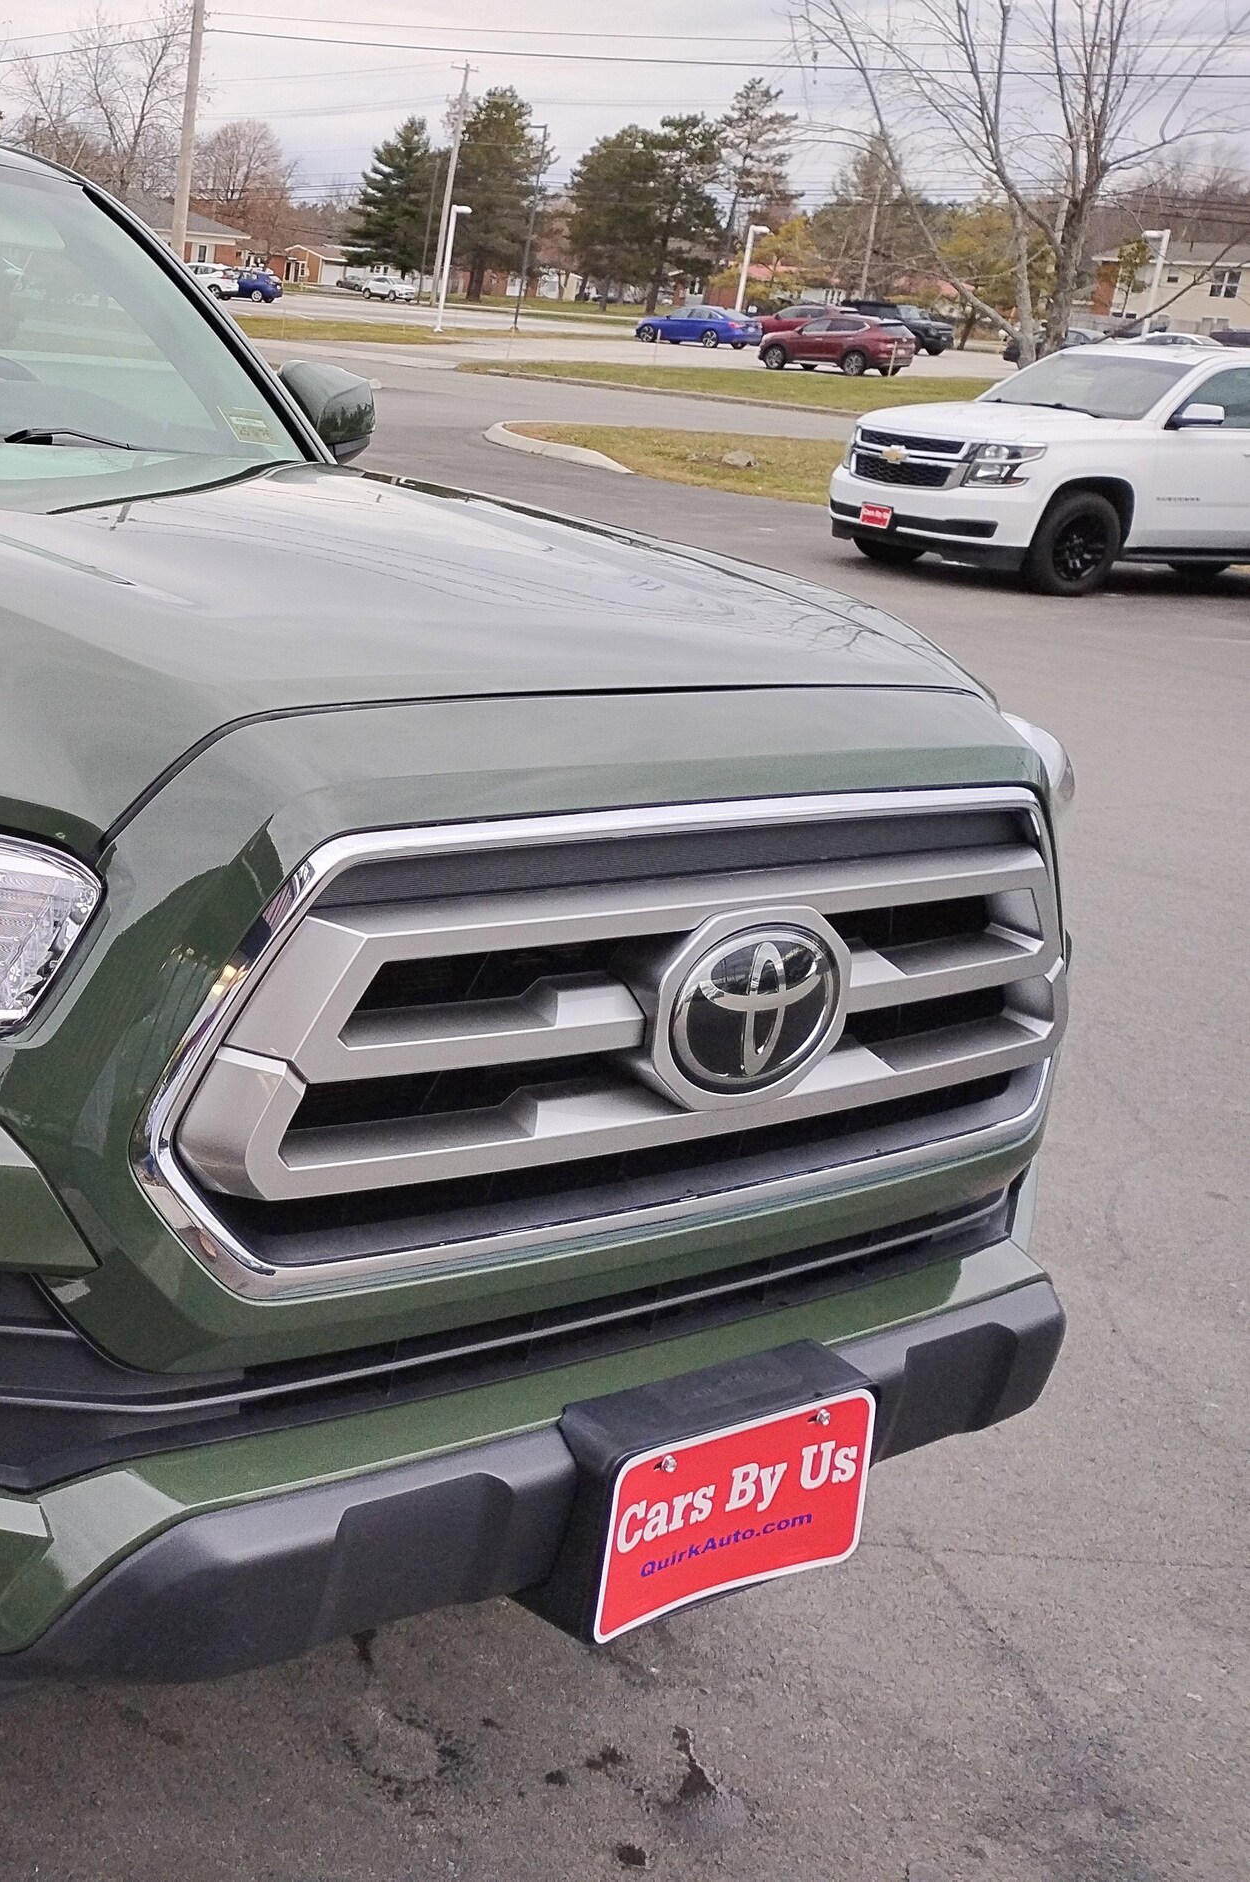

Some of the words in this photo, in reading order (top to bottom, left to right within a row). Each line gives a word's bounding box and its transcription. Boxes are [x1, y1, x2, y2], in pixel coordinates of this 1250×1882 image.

[616, 1483, 716, 1553] Cars
[725, 1462, 788, 1512] By
[800, 1440, 857, 1490] Us
[640, 1512, 813, 1578] QuirkAuto.com
